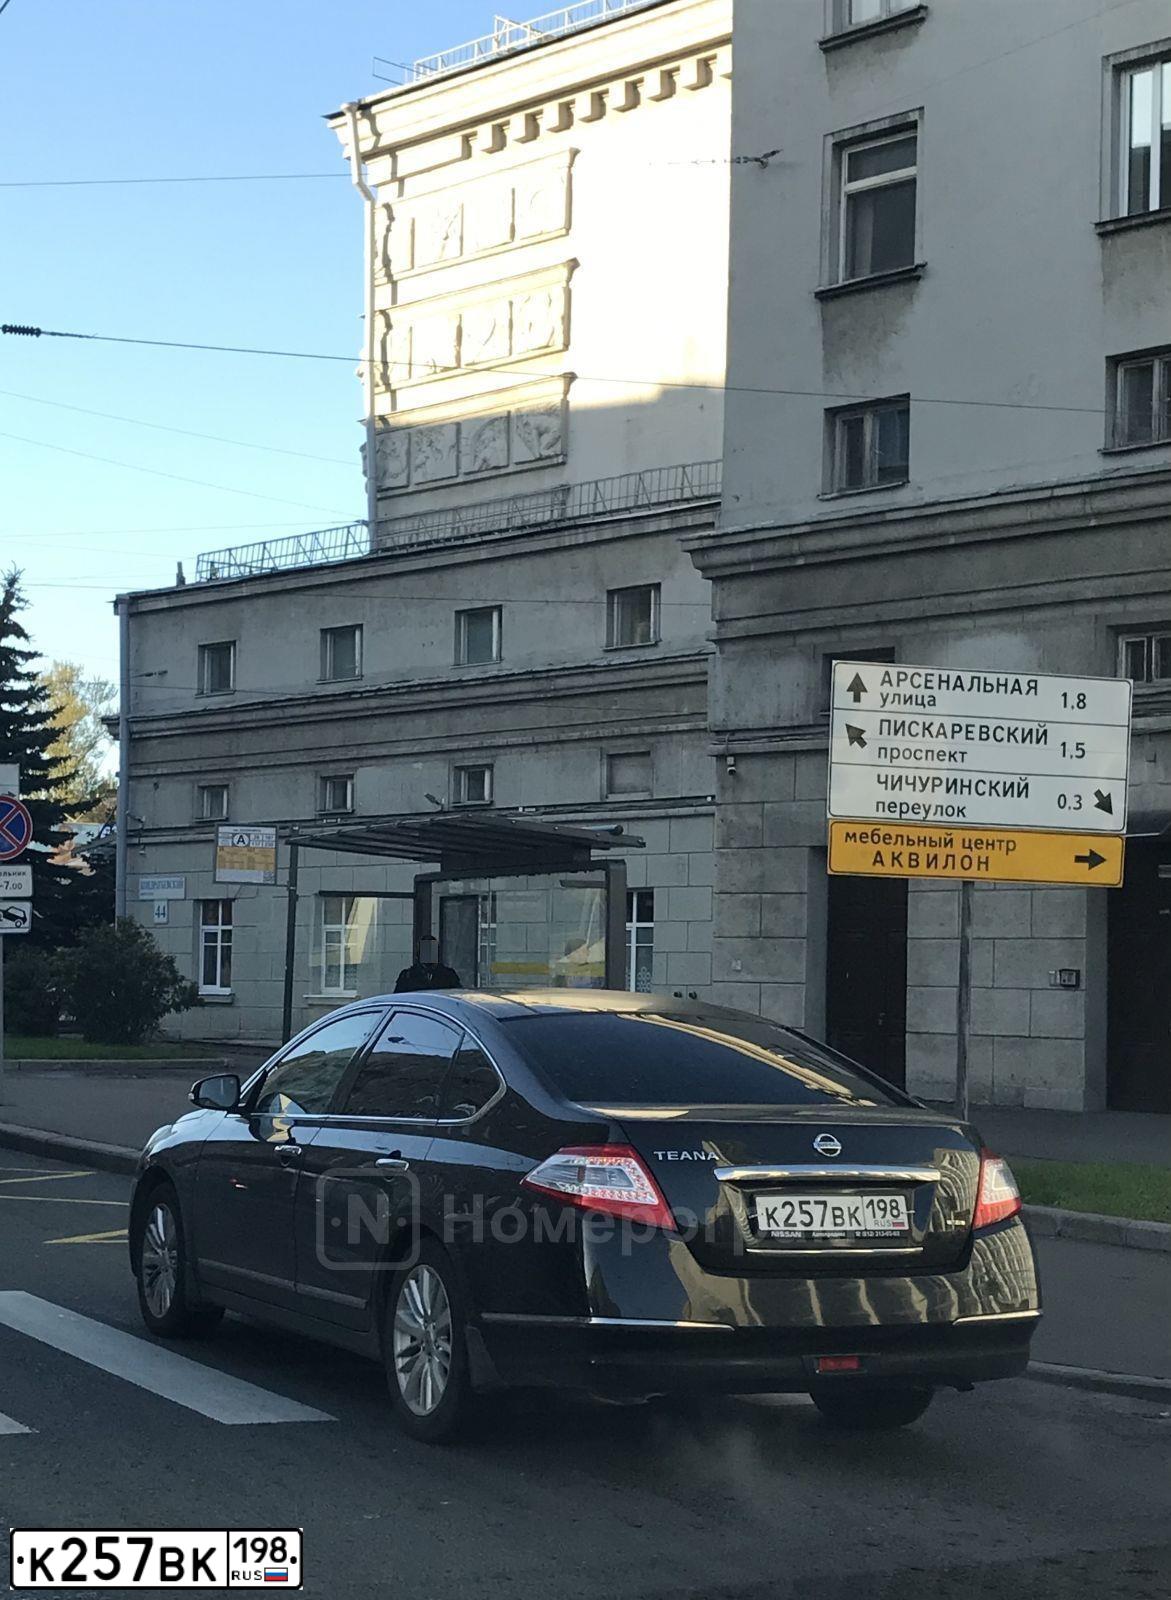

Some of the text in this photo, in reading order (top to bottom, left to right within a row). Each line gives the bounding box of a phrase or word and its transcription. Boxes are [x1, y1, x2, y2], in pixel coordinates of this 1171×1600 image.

[880, 670, 1039, 696] АРСЕНАЛЬНАЯ
[880, 690, 937, 708] улица
[1060, 692, 1087, 710] 1.8
[878, 718, 1049, 746] ПИСКАРЕВСКИЙ
[877, 745, 968, 764] проспект
[1059, 742, 1086, 759] 1.5
[877, 773, 1030, 799] ЧИЧУРИНСКИЙ
[875, 801, 967, 820] переулок
[1057, 794, 1083, 810] 0.3
[844, 828, 1017, 855] мебельный центр
[872, 850, 990, 872] АКВИЛОН
[154, 905, 167, 918] 44
[653, 1150, 719, 1161] TEANA
[765, 1199, 901, 1228] К257ВК 198
[874, 1220, 892, 1228] RUS
